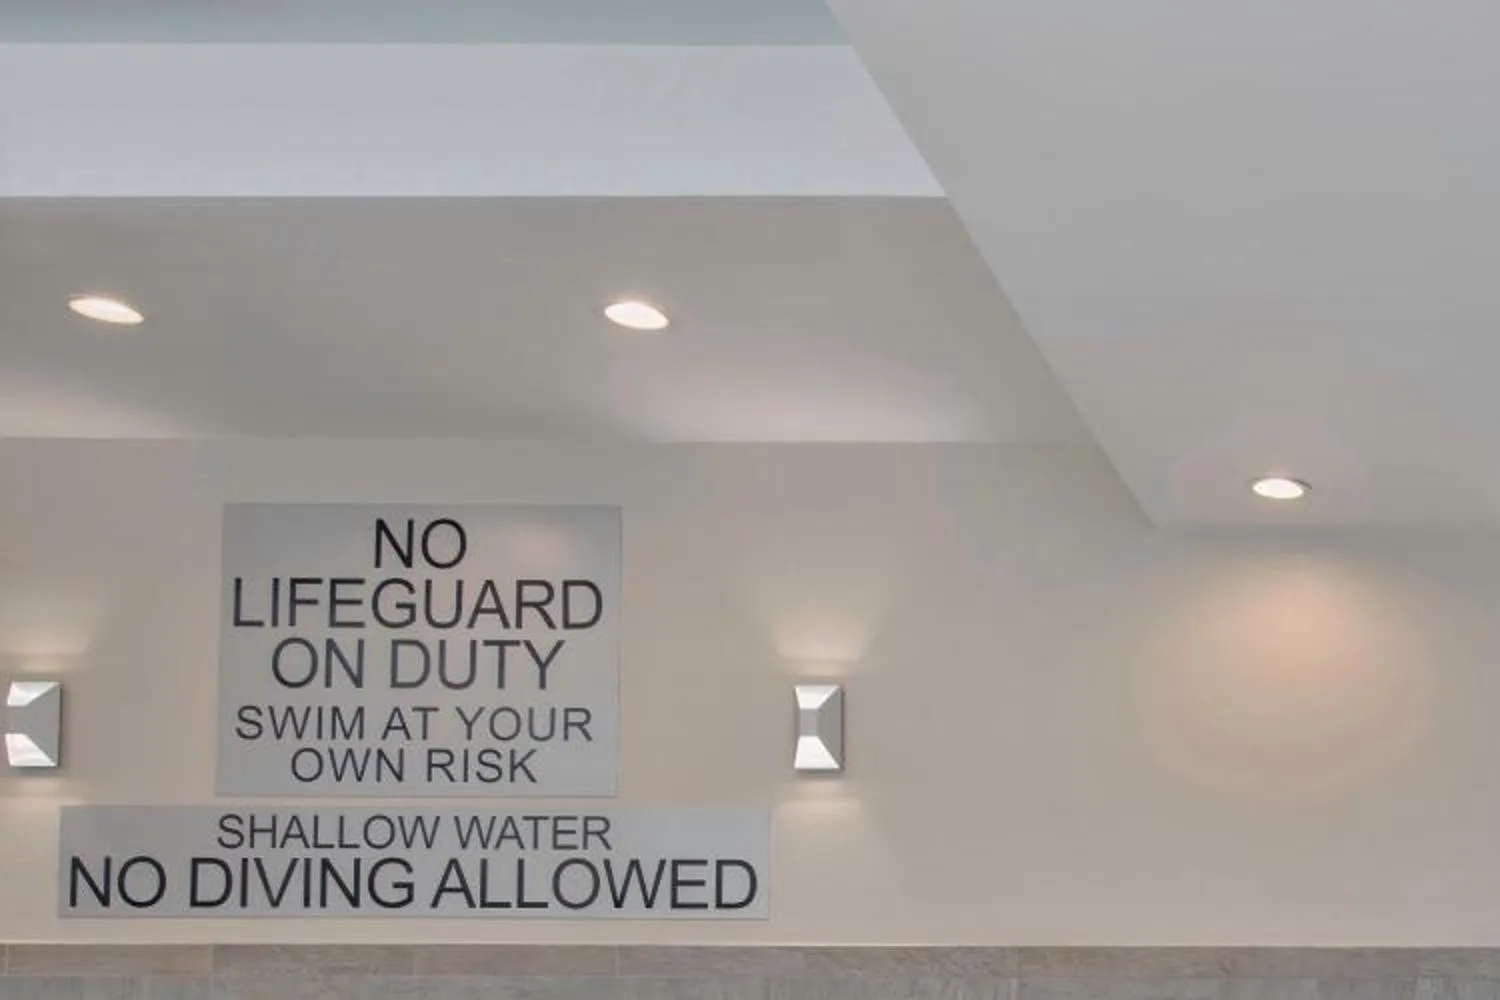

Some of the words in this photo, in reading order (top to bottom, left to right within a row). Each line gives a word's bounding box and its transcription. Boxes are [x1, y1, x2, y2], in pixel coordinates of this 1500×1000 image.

[374, 518, 467, 569] NO
[233, 577, 603, 630] LIFEGUARD
[271, 637, 364, 689] ON
[391, 639, 565, 690] DUTY
[236, 705, 365, 740] SWIM
[382, 707, 439, 740] AT
[456, 706, 593, 742] YOUR
[290, 747, 405, 783] OWN
[427, 748, 537, 783] RISK
[216, 813, 441, 850] SHALLOW
[454, 816, 612, 850] WATER
[69, 856, 167, 908] NO
[190, 857, 415, 909] DIVING
[430, 858, 758, 910] ALLOWED
